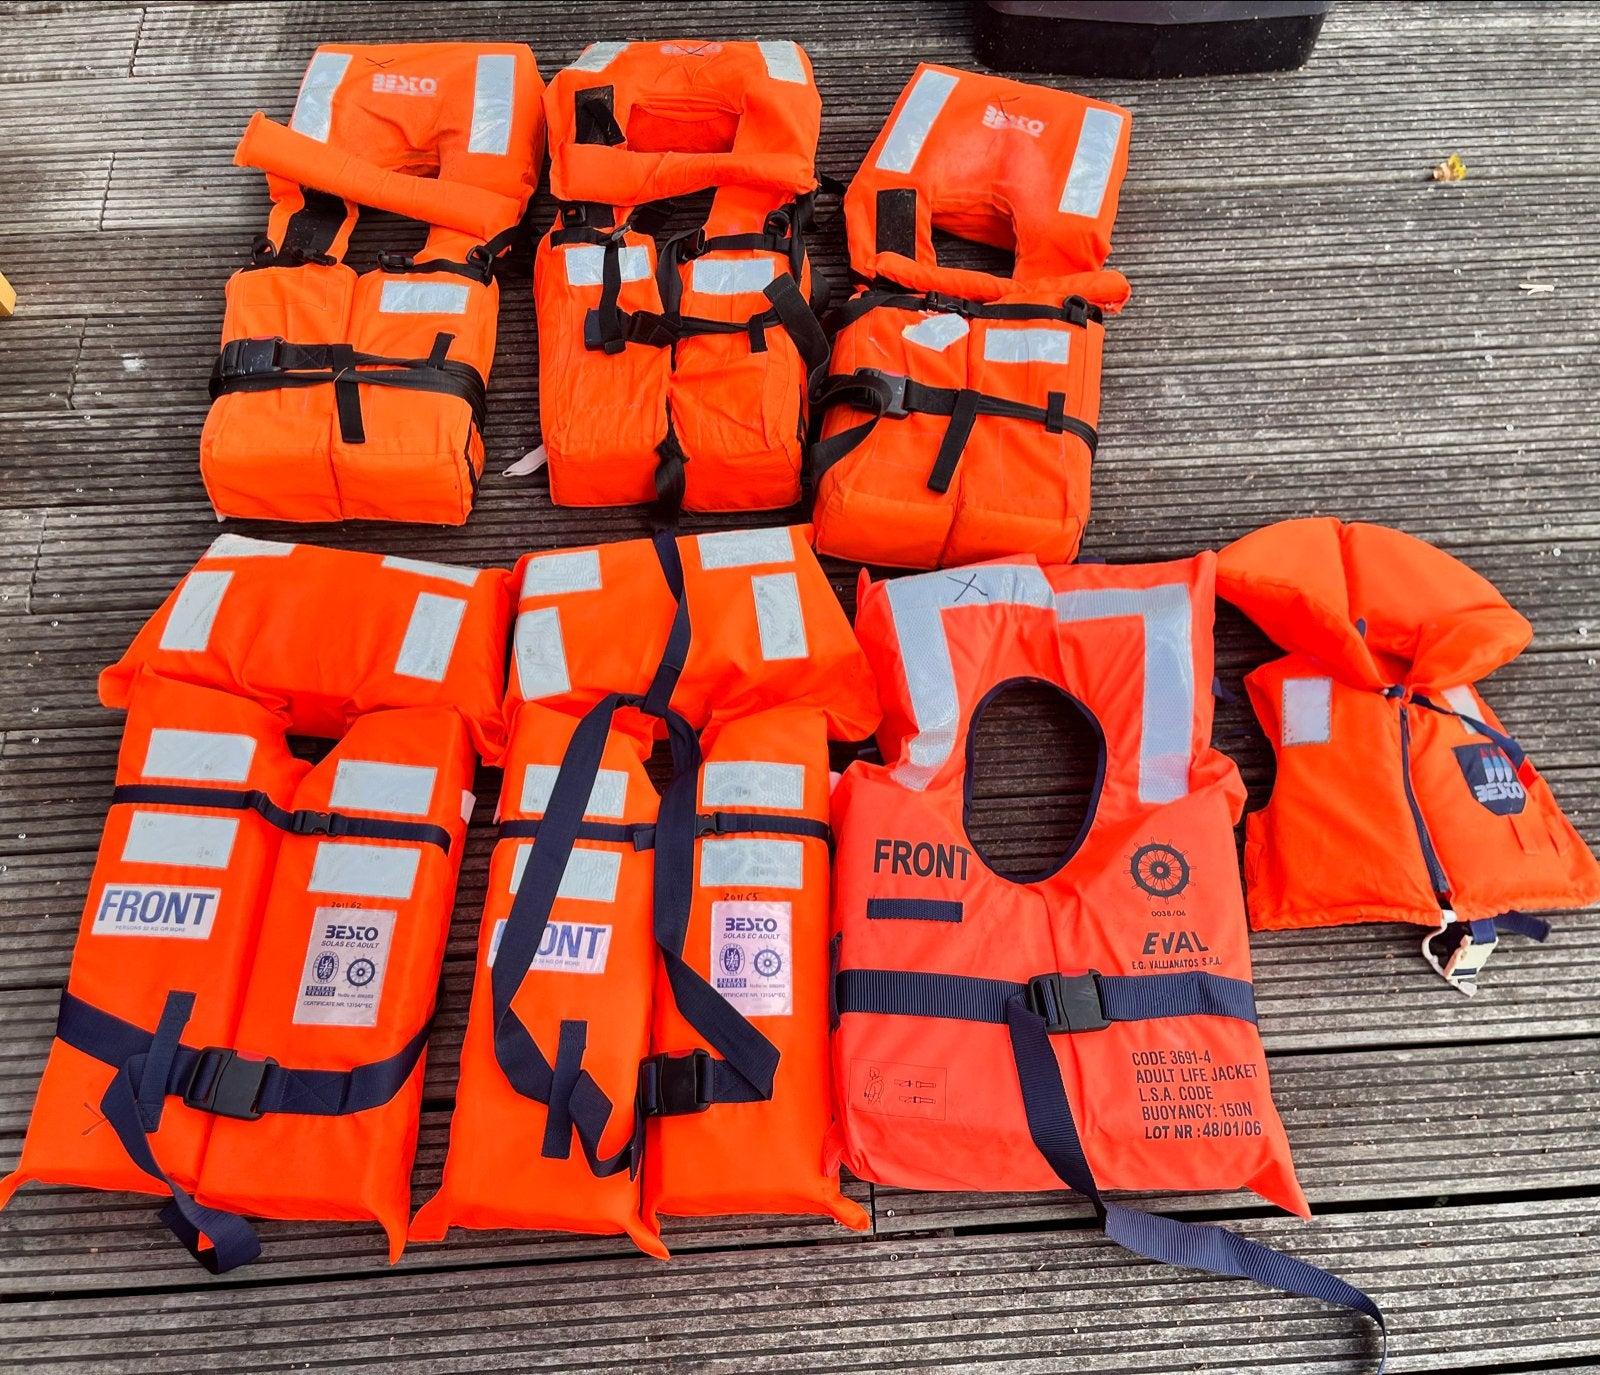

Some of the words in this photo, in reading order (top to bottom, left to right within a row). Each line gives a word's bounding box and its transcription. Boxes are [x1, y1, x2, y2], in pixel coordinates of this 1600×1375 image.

[372, 73, 437, 94] BESTO
[1474, 782, 1524, 802] BESTO
[873, 839, 972, 881] FRONT
[98, 890, 215, 925] FRONT
[325, 925, 379, 941] BESTO
[725, 917, 778, 932] BESTO
[321, 940, 345, 948] SOLAS
[722, 932, 746, 940] SOLAS
[1142, 931, 1209, 955] EVAL
[1132, 961, 1147, 970] E.G.
[1149, 959, 1199, 969] VALLIANATOS
[1132, 1051, 1167, 1066] CODE
[1169, 1050, 1211, 1064] 3691-4
[1136, 1068, 1175, 1084] ADULT
[1181, 1067, 1208, 1083] LIFE
[1211, 1063, 1259, 1082] JACKET
[1139, 1087, 1176, 1102] L.S.A.
[1179, 1086, 1214, 1100] CODE
[1142, 1103, 1218, 1121] BUOYANCY:
[1220, 1101, 1253, 1117] 150N
[1145, 1125, 1169, 1139] LOT
[1202, 1120, 1262, 1137] 48/01/06
